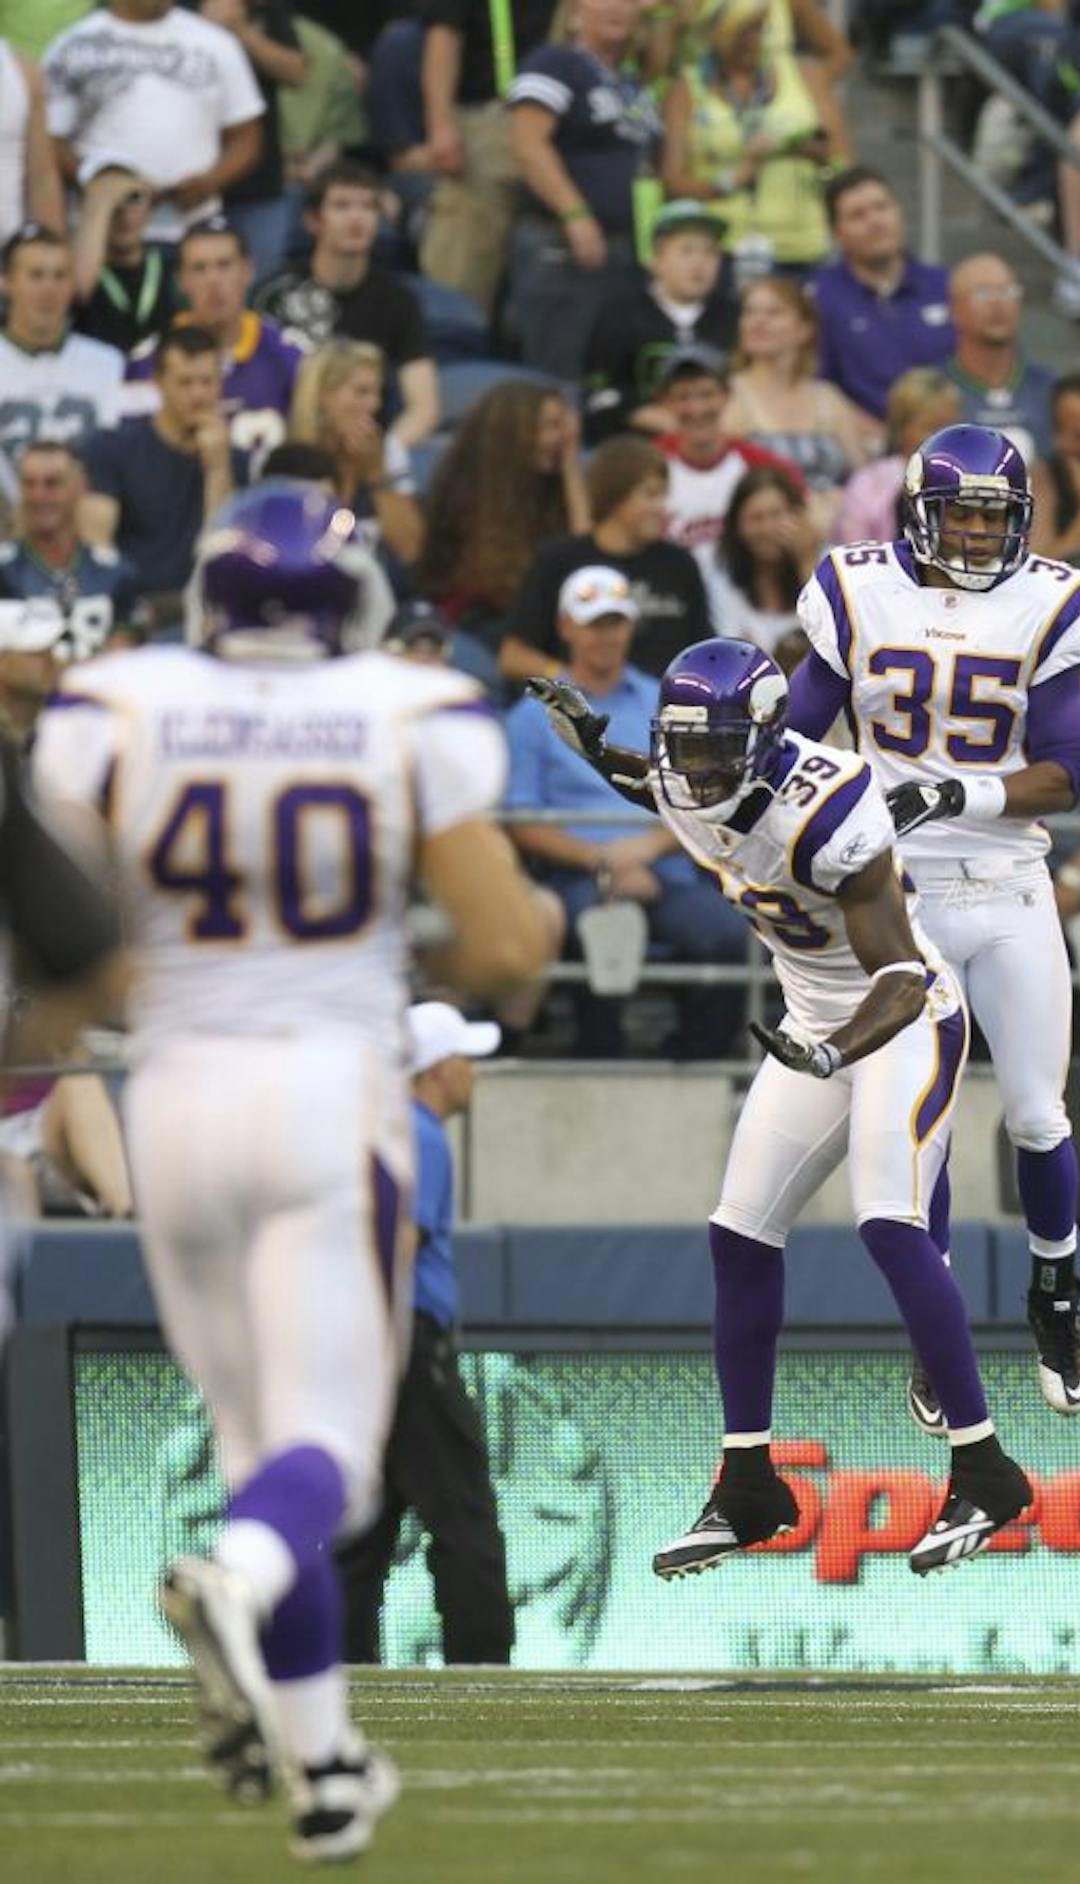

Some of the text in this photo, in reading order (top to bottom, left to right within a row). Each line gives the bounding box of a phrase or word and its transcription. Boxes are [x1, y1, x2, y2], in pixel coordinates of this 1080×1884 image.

[867, 646, 1024, 764] 35
[782, 755, 841, 807] 39
[149, 781, 376, 940] 40
